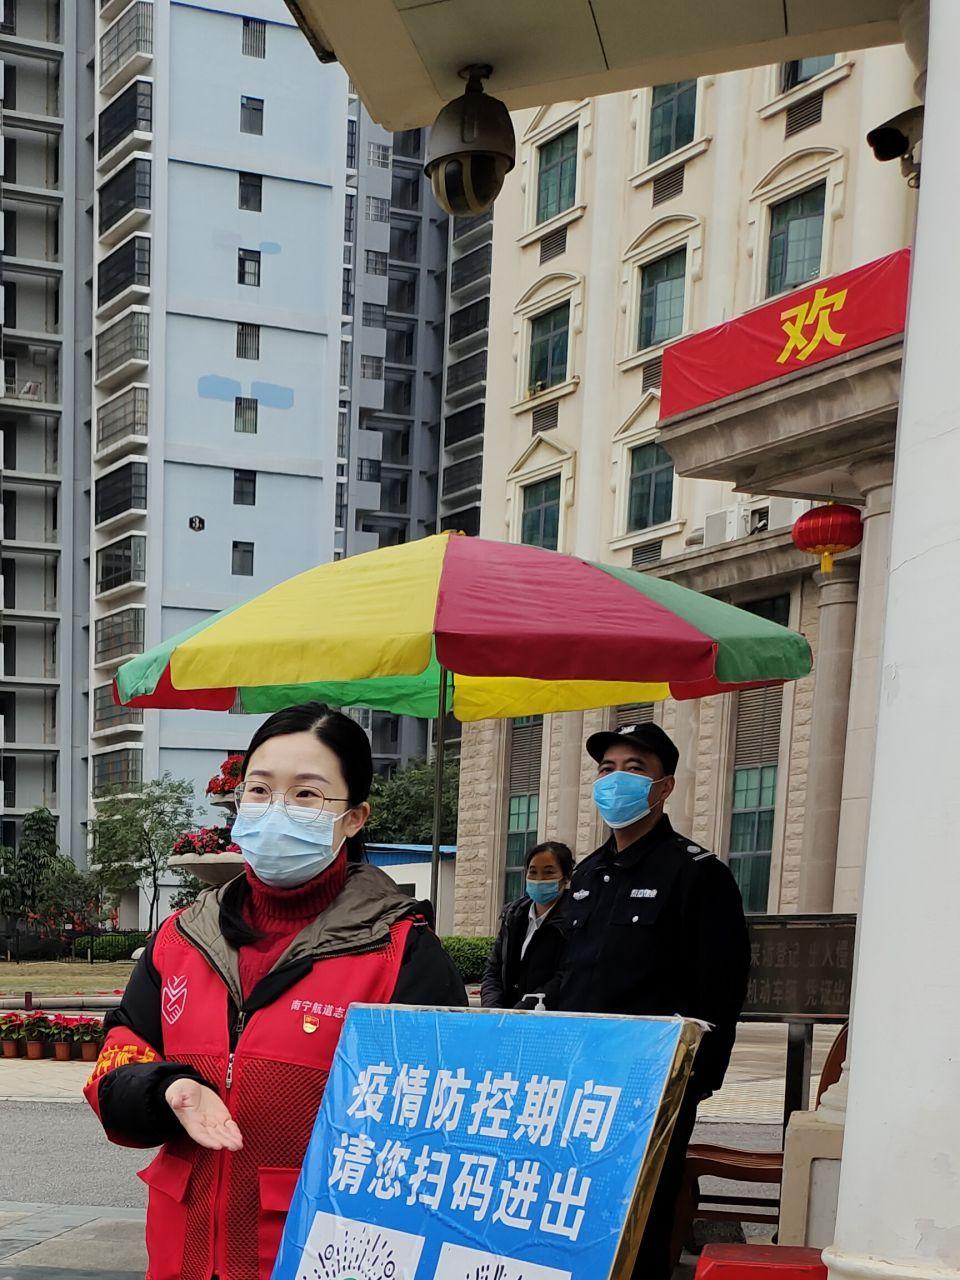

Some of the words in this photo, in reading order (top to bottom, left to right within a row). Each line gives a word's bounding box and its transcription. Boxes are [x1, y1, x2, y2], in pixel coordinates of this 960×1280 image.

[776, 287, 848, 364] 欢
[346, 1062, 622, 1153] 疫情防控期间
[326, 1132, 592, 1242] 请您扫码进出
